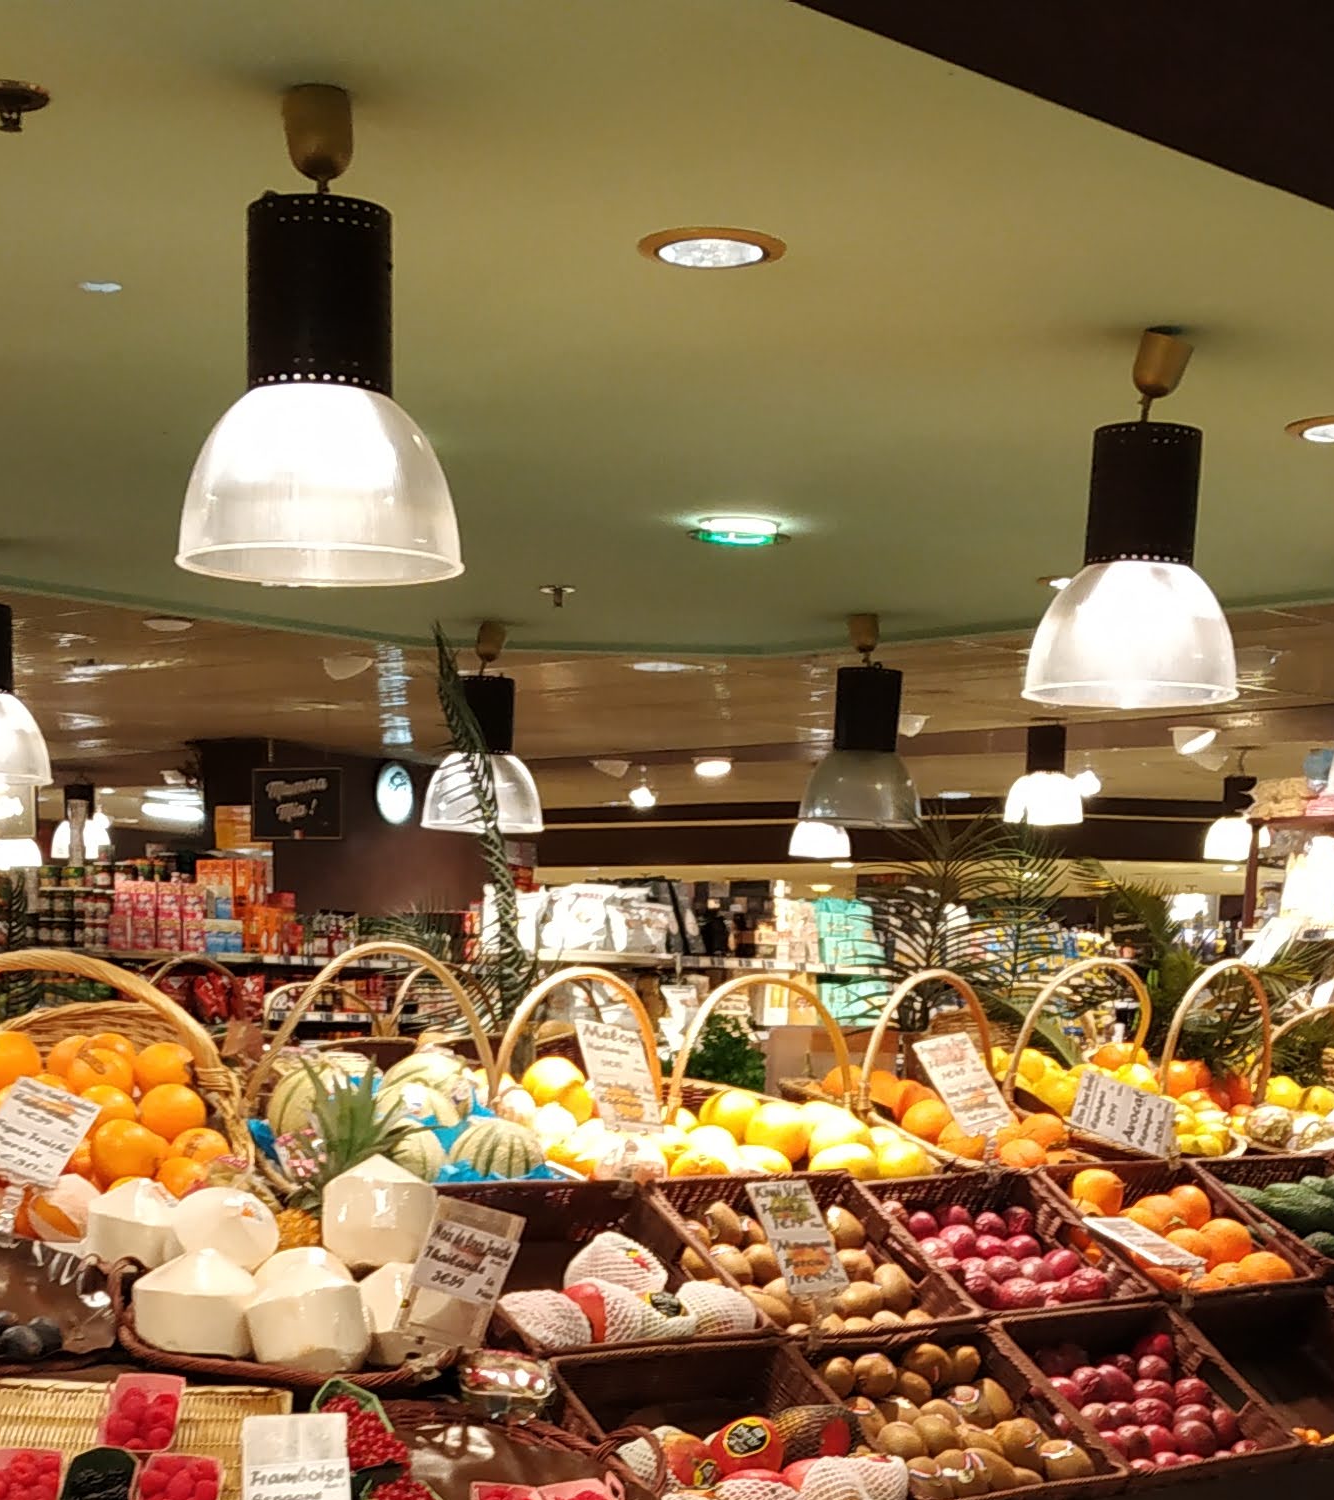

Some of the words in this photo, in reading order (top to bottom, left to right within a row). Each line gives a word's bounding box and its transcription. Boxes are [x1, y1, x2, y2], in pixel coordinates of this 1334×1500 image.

[276, 802, 307, 822] Mia
[1122, 1089, 1148, 1143] Avocat
[250, 1465, 346, 1487] Framboise
